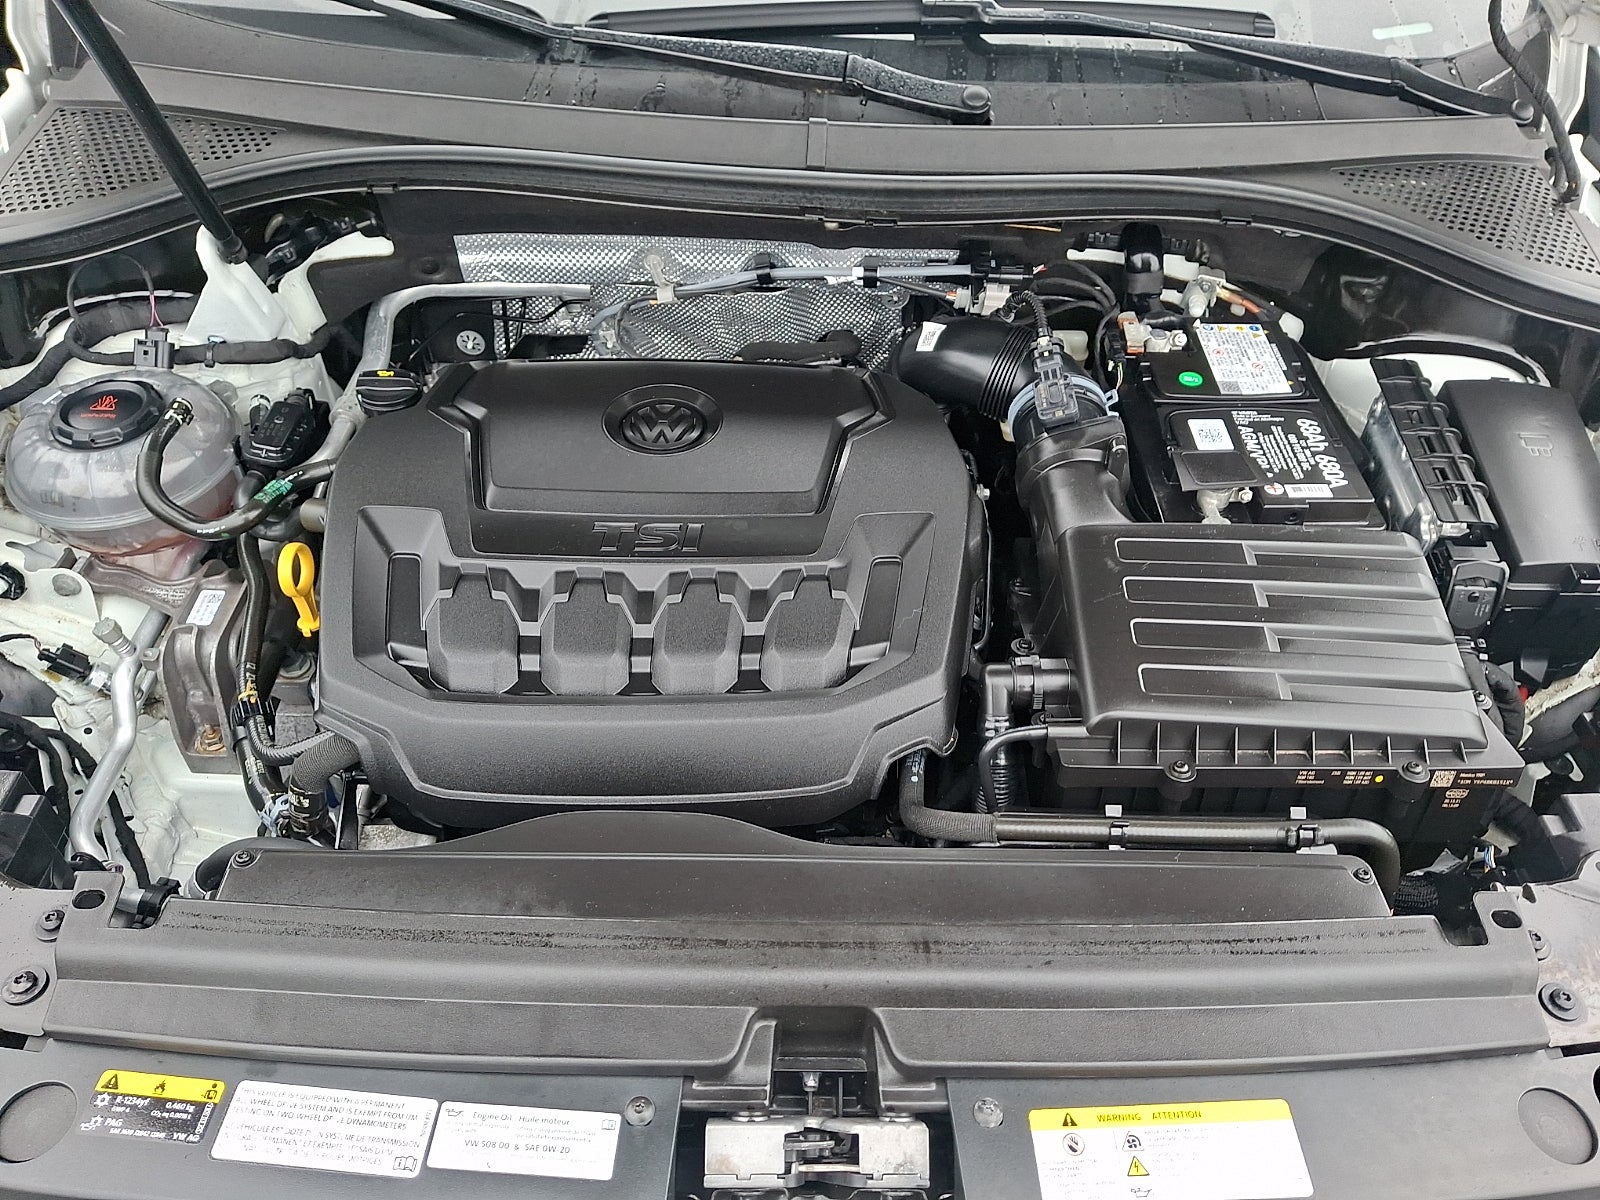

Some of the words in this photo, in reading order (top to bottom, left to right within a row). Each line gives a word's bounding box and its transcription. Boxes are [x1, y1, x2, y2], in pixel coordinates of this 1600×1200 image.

[1296, 418, 1328, 451] 68Ah
[1314, 454, 1349, 489] 680A
[592, 521, 705, 552] TSI
[298, 1102, 327, 1112] SYSTEM
[328, 1106, 345, 1114] AND
[353, 1108, 382, 1117] EXEMPT
[383, 1111, 404, 1119] FROM
[1152, 1110, 1202, 1120] ATTENTION
[104, 1118, 124, 1127] PAG
[346, 1117, 407, 1130] DYNAMOMETERS
[472, 1111, 500, 1122] Engine
[500, 1113, 513, 1121] Oil
[518, 1115, 540, 1123] Huile
[541, 1117, 570, 1126] moteur
[1096, 1114, 1142, 1123] WARNING
[172, 1132, 187, 1141] VW
[186, 1134, 200, 1143] AG
[368, 1136, 420, 1149] TRANSMISSION
[464, 1139, 480, 1147] VW
[481, 1140, 497, 1149] 508
[498, 1141, 510, 1150] 00
[513, 1143, 520, 1151] &
[525, 1143, 540, 1152] SAE
[542, 1144, 571, 1154] 0W-20
